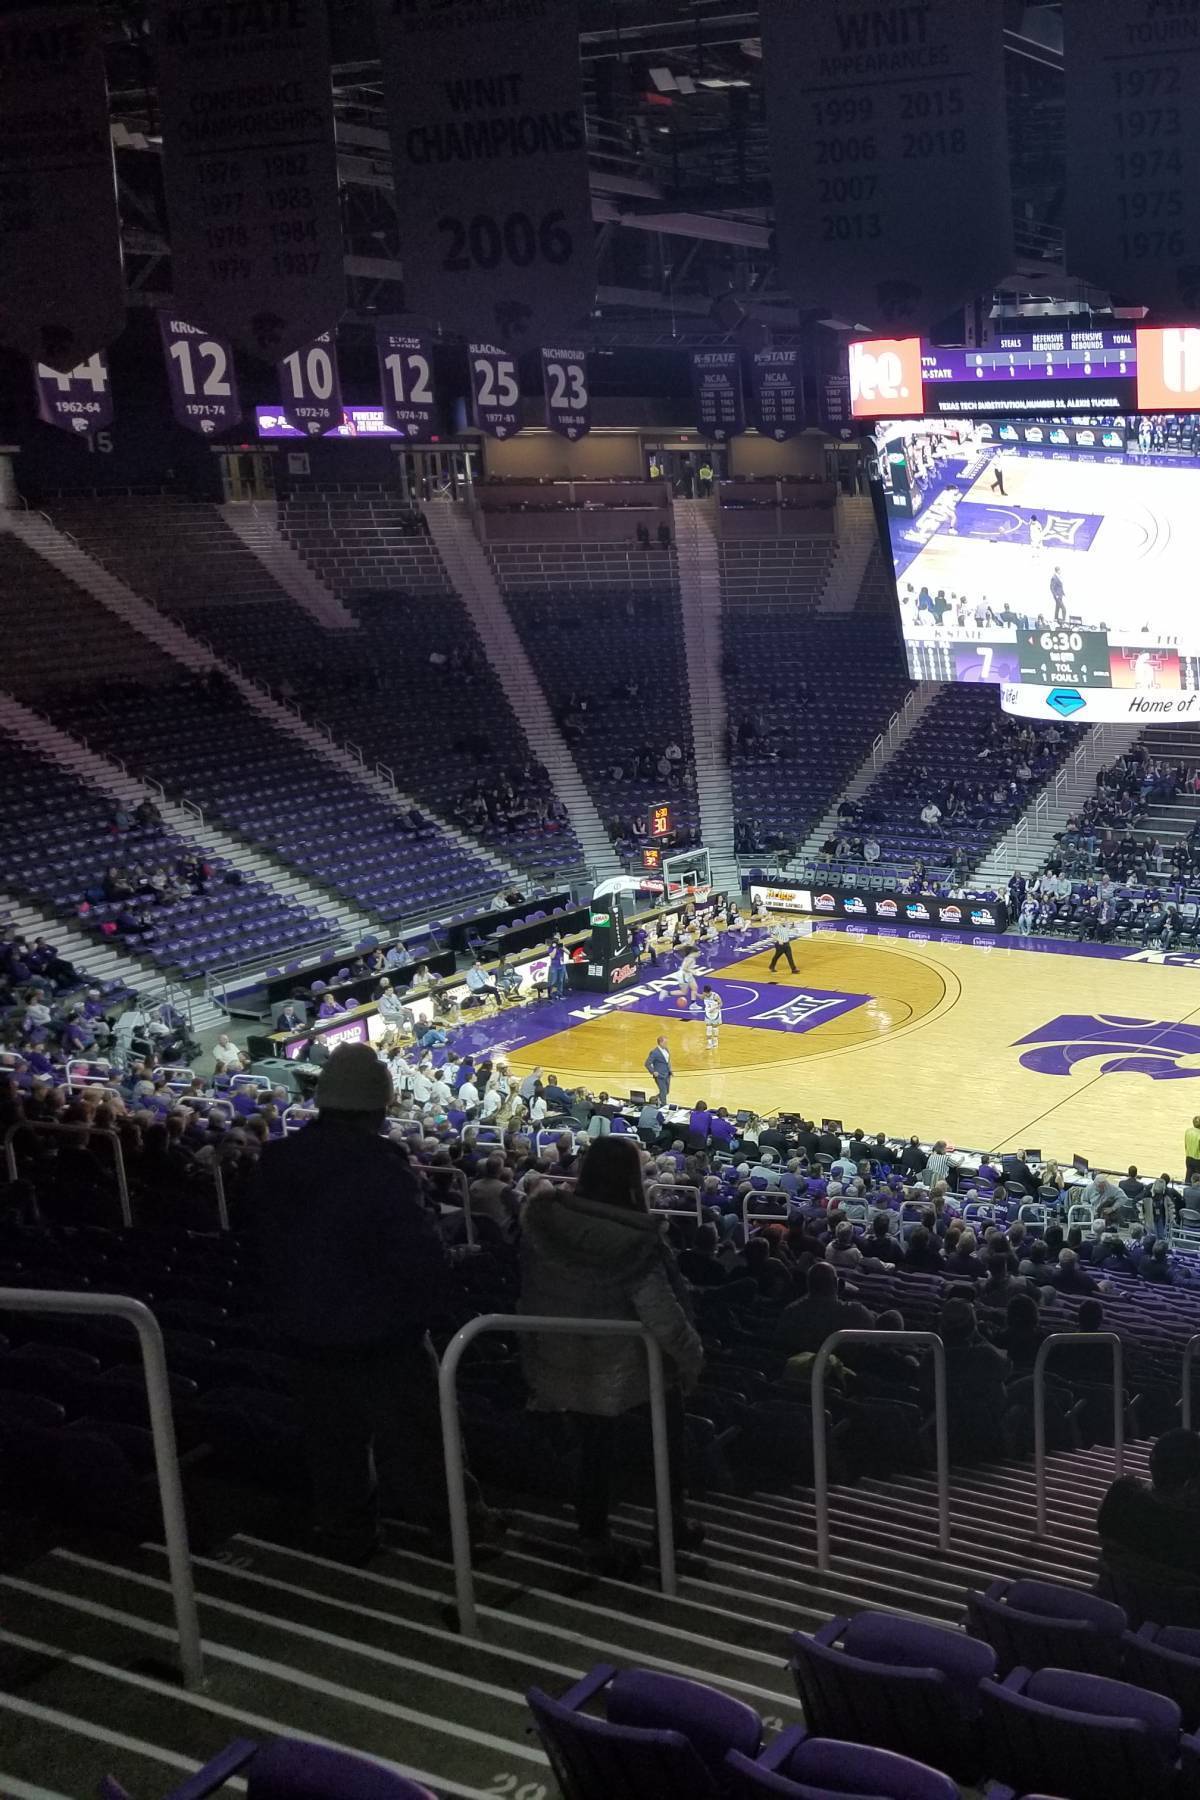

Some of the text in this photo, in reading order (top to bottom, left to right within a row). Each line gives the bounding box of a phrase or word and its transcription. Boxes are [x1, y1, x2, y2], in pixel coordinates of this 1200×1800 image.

[835, 3, 931, 52] WNIT
[819, 44, 950, 77] APPEARANCES
[1111, 66, 1182, 99] 1972
[445, 73, 523, 111] WNIT
[811, 96, 874, 126] 1999
[899, 87, 965, 120] 2015
[1112, 107, 1182, 139] 1973
[406, 110, 583, 165] CHAMPIONS
[902, 127, 967, 160] 2018
[814, 135, 878, 165] 2006
[1115, 148, 1183, 180] 1974
[817, 174, 880, 203] 2007
[1117, 189, 1184, 221] 1975
[820, 212, 882, 241] 2013
[437, 208, 573, 271] 2006
[1118, 229, 1185, 263] 1976
[1001, 340, 1021, 348] STEALS
[1033, 334, 1064, 343] DEFENSIVE
[1033, 342, 1064, 350] REBOUNDS
[1071, 333, 1103, 342] OFFENSIVE
[1072, 341, 1103, 350] REBOUNDS
[1113, 335, 1131, 344] TOTAL
[542, 348, 585, 360] RICHMOND
[694, 352, 736, 364] K-STATE
[754, 351, 797, 362] K-STATE
[921, 357, 937, 366] TTU
[170, 341, 231, 396] 12
[283, 348, 333, 400] 10
[764, 373, 788, 381] NCAA
[922, 369, 952, 378] K-STATE
[385, 354, 433, 403] 12
[474, 359, 519, 406] 25
[547, 364, 588, 409] 23
[56, 401, 101, 413] 1962-64
[186, 405, 225, 415] 1971-74
[295, 407, 330, 417] 1972-76
[396, 410, 429, 420] 1974-78
[939, 402, 959, 410] TEXAS
[960, 402, 977, 410] TECH
[1040, 633, 1082, 651] 6:30
[976, 647, 994, 678] 7
[1055, 664, 1087, 673] TOL 4
[1051, 673, 1079, 682] FOULS
[1129, 697, 1172, 712] Home
[1177, 695, 1195, 712] of
[654, 818, 668, 834] 30
[875, 902, 898, 914] Kansas
